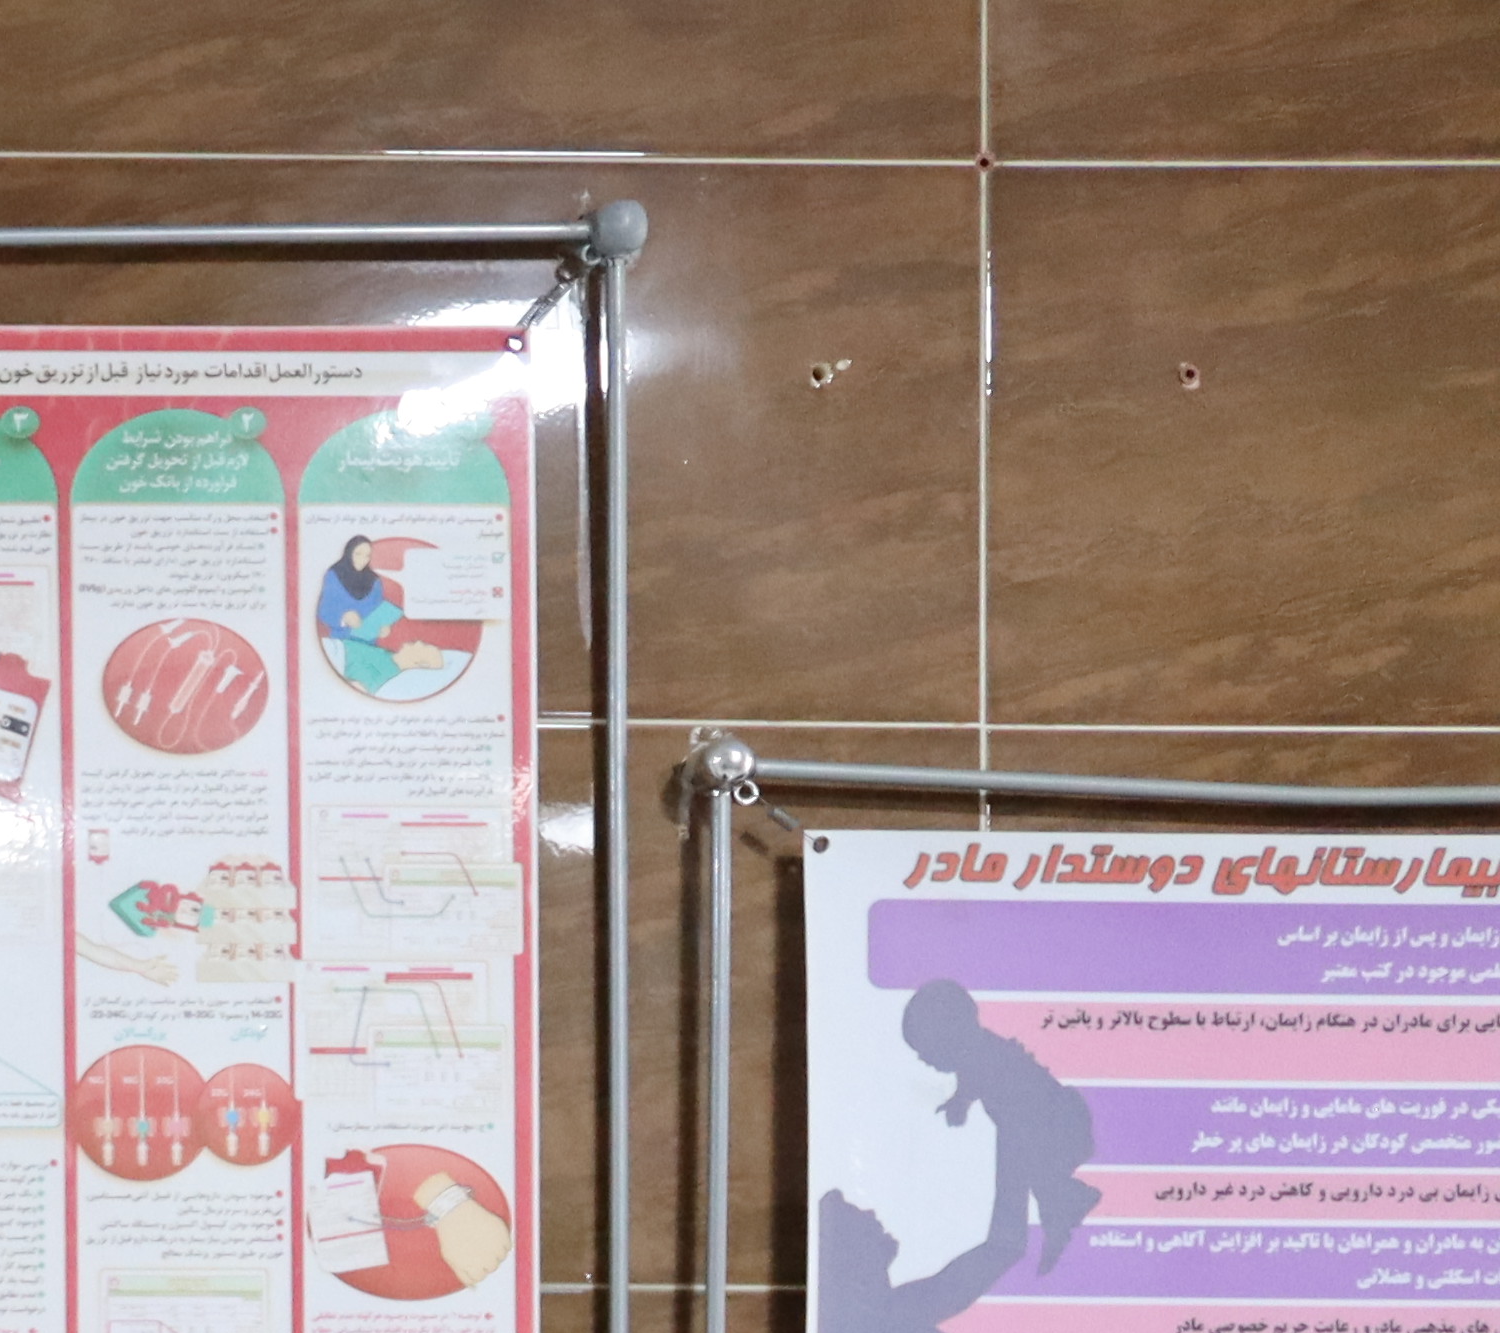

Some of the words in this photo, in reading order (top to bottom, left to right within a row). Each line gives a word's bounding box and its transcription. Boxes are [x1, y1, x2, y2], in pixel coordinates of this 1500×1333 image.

[36, 361, 84, 385] تزریق
[86, 361, 99, 385] از
[101, 361, 128, 385] قبل
[136, 361, 165, 385] نیاز
[166, 361, 199, 385] مورد
[205, 361, 267, 385] اقدامات
[902, 843, 1008, 887] مادر
[1014, 844, 1205, 891] دوستدار
[1040, 1008, 1054, 1034] تر
[1097, 1008, 1105, 1034] و
[1108, 1008, 1146, 1034] بالاتر
[1148, 1008, 1192, 1034] سطوح
[1195, 1008, 1206, 1034] با
[1209, 1008, 1256, 1034] ارتباط
[1315, 1008, 1356, 1034] هنگام
[1362, 1008, 1377, 1034] در
[1383, 1008, 1433, 1034] مادران
[1437, 1008, 1470, 1034] برای
[1155, 1180, 1207, 1203] دارویی
[1211, 1180, 1234, 1203] غیر
[1238, 1180, 1265, 1203] درد
[1270, 1180, 1313, 1203] کاهش
[1319, 1180, 1326, 1203] و
[1331, 1180, 1382, 1203] دارویی
[1388, 1180, 1414, 1203] درد
[1419, 1180, 1439, 1203] بی
[1442, 1180, 1490, 1203] زایمان
